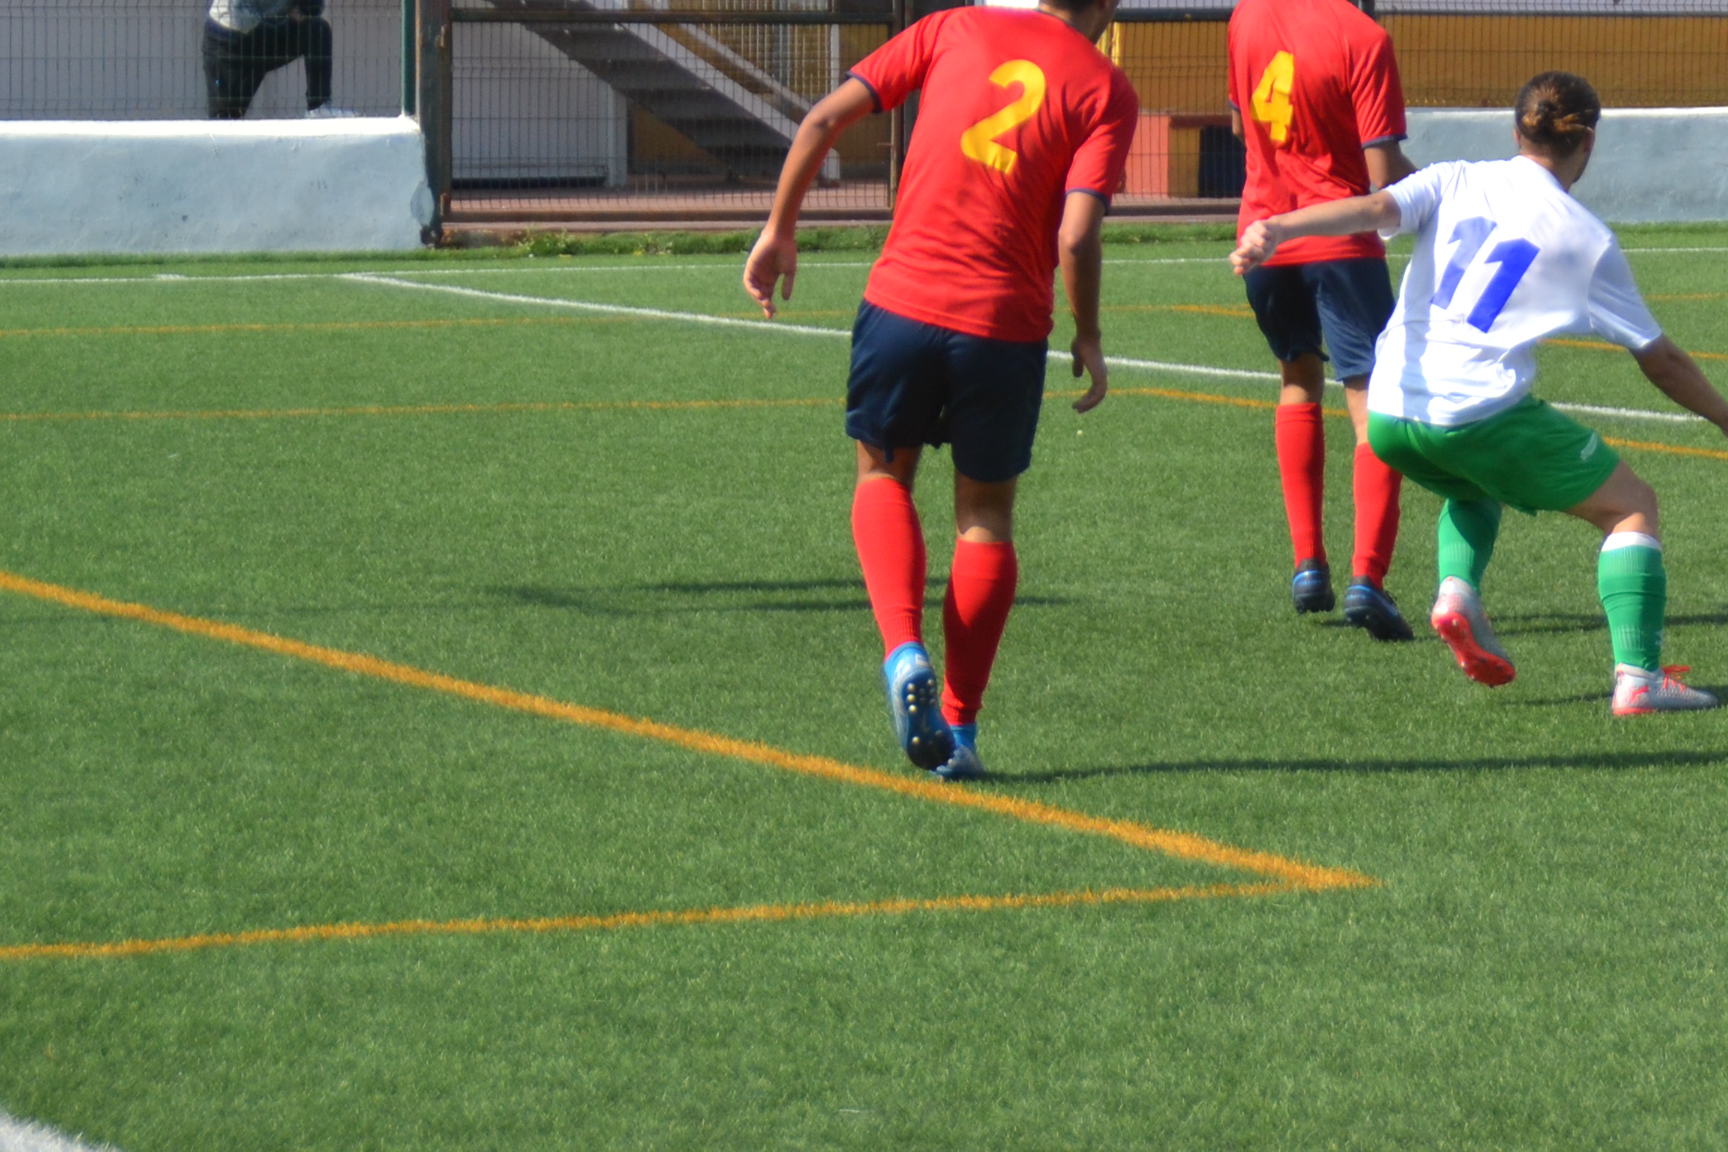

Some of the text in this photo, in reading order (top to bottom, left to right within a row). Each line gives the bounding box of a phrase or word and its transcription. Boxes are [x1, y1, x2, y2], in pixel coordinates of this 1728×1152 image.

[960, 59, 1046, 175] 2
[1250, 50, 1295, 144] 4
[1430, 215, 1541, 335] 11
